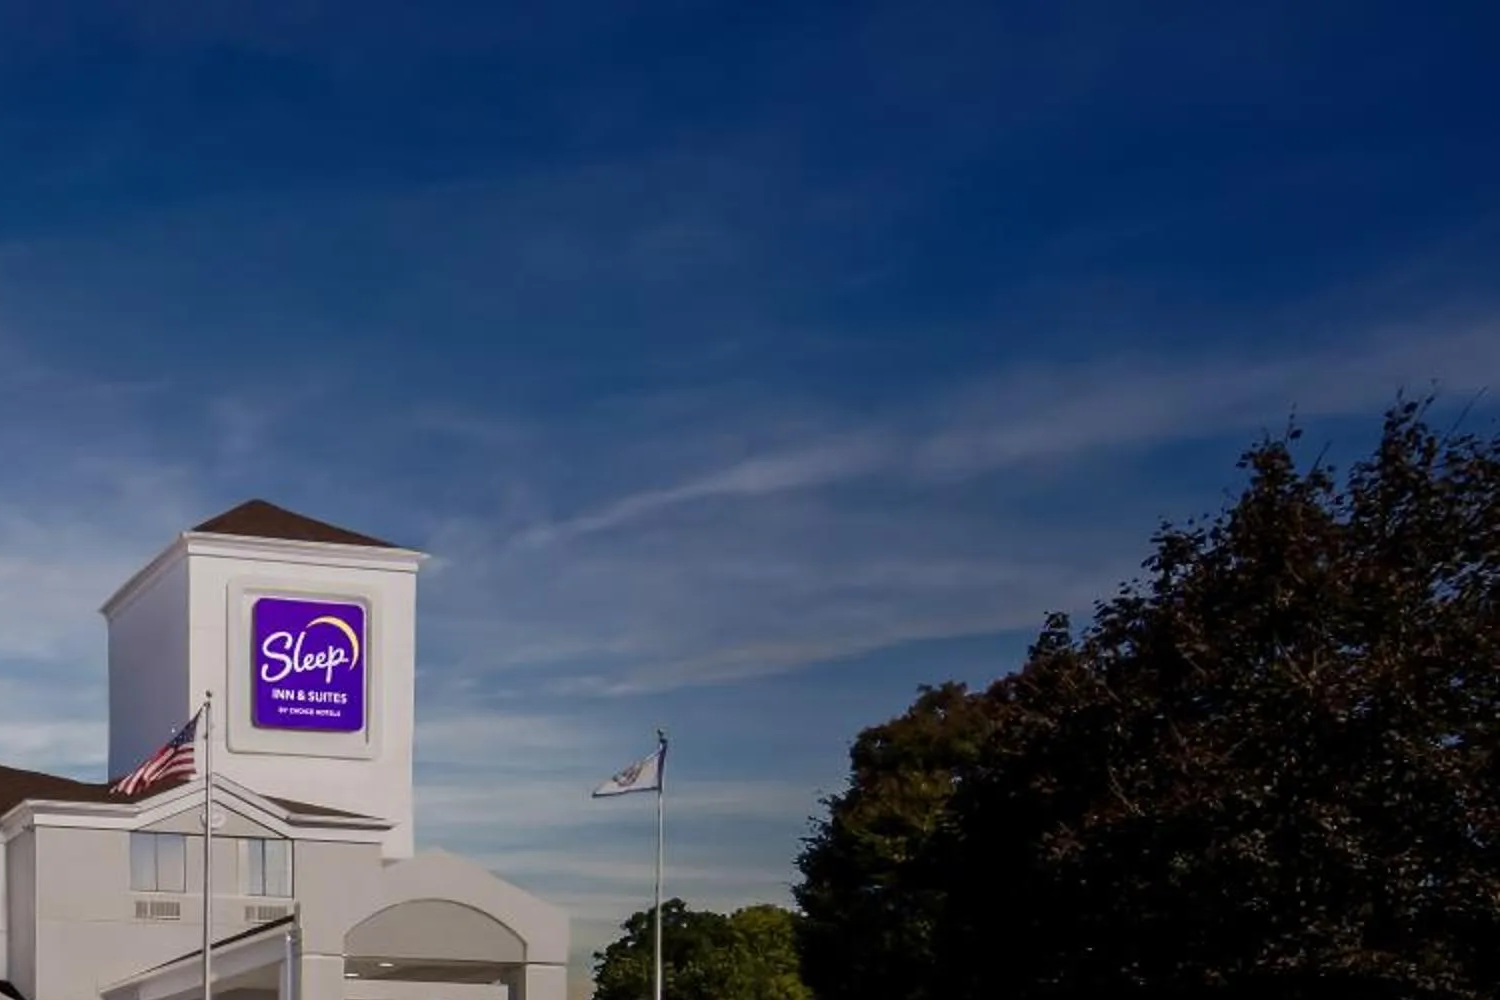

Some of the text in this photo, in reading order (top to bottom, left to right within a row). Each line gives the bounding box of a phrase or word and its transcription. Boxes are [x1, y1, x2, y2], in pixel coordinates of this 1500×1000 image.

[261, 631, 349, 684] Sleep
[272, 688, 348, 704] INN & SUITES
